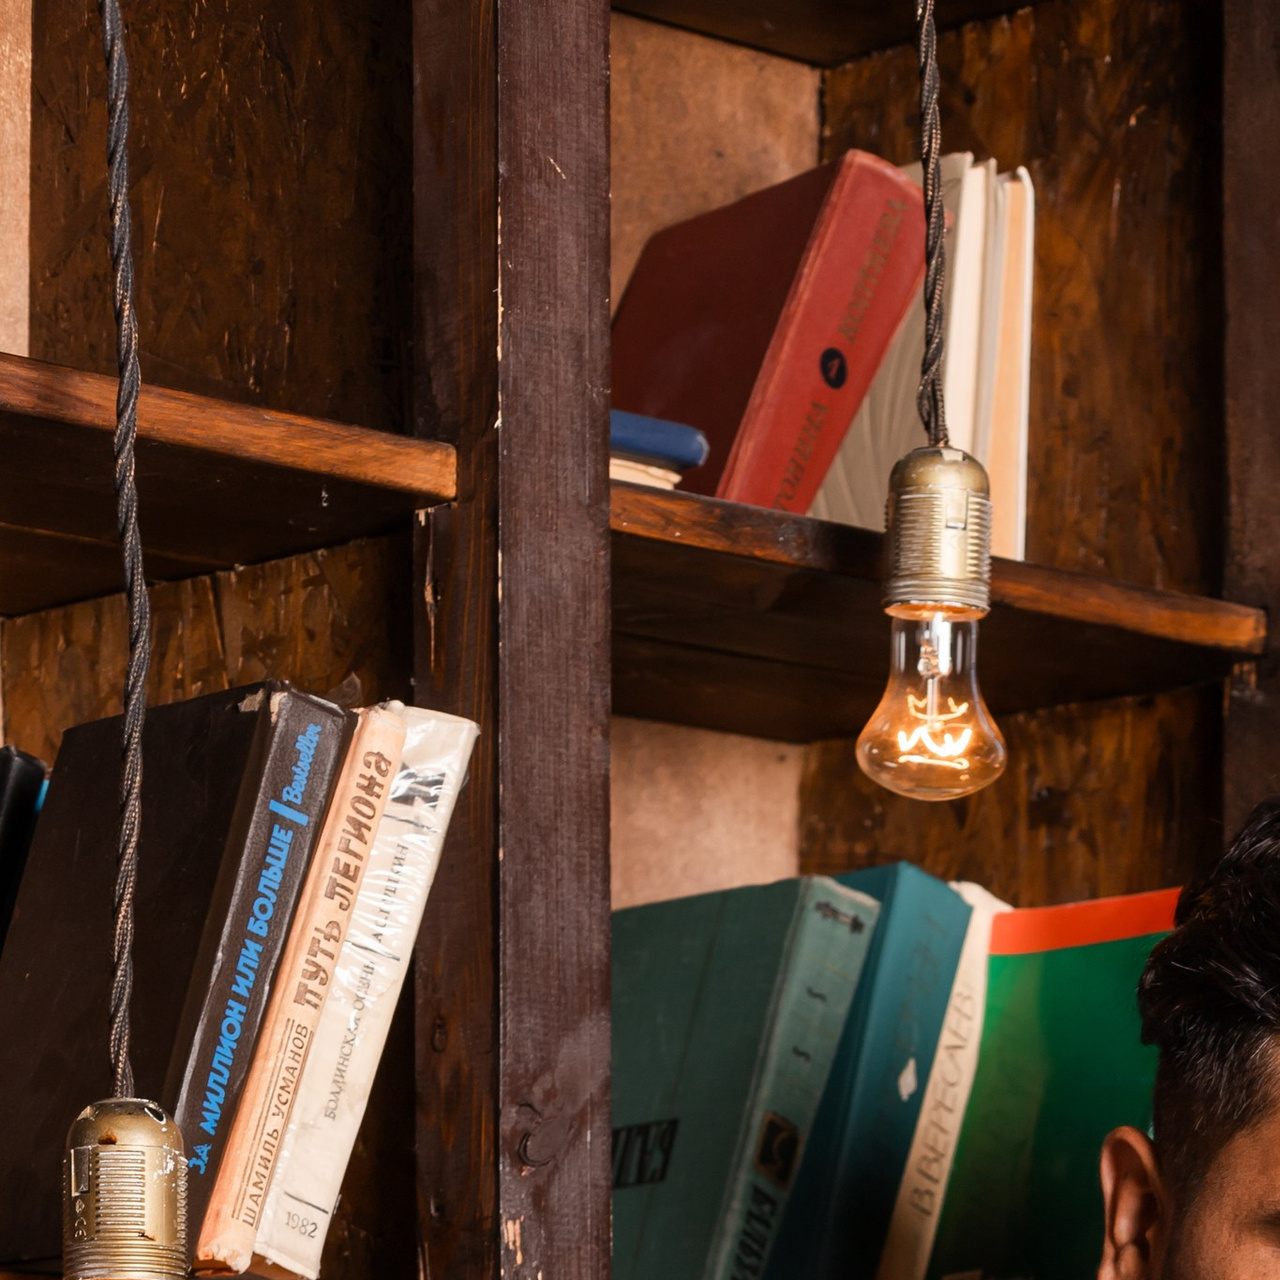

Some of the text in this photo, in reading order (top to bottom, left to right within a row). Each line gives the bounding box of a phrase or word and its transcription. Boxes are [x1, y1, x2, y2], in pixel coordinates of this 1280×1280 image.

[282, 722, 323, 805] Bestseller
[188, 823, 295, 1175] ЗА МИЛЛИОН ИЛИ БОЛЬШЕ
[293, 920, 342, 1011] ПУТЬ
[242, 1023, 309, 1228] ШАМИЛЬ УСМАНОВ
[285, 1210, 319, 1240] 1982
